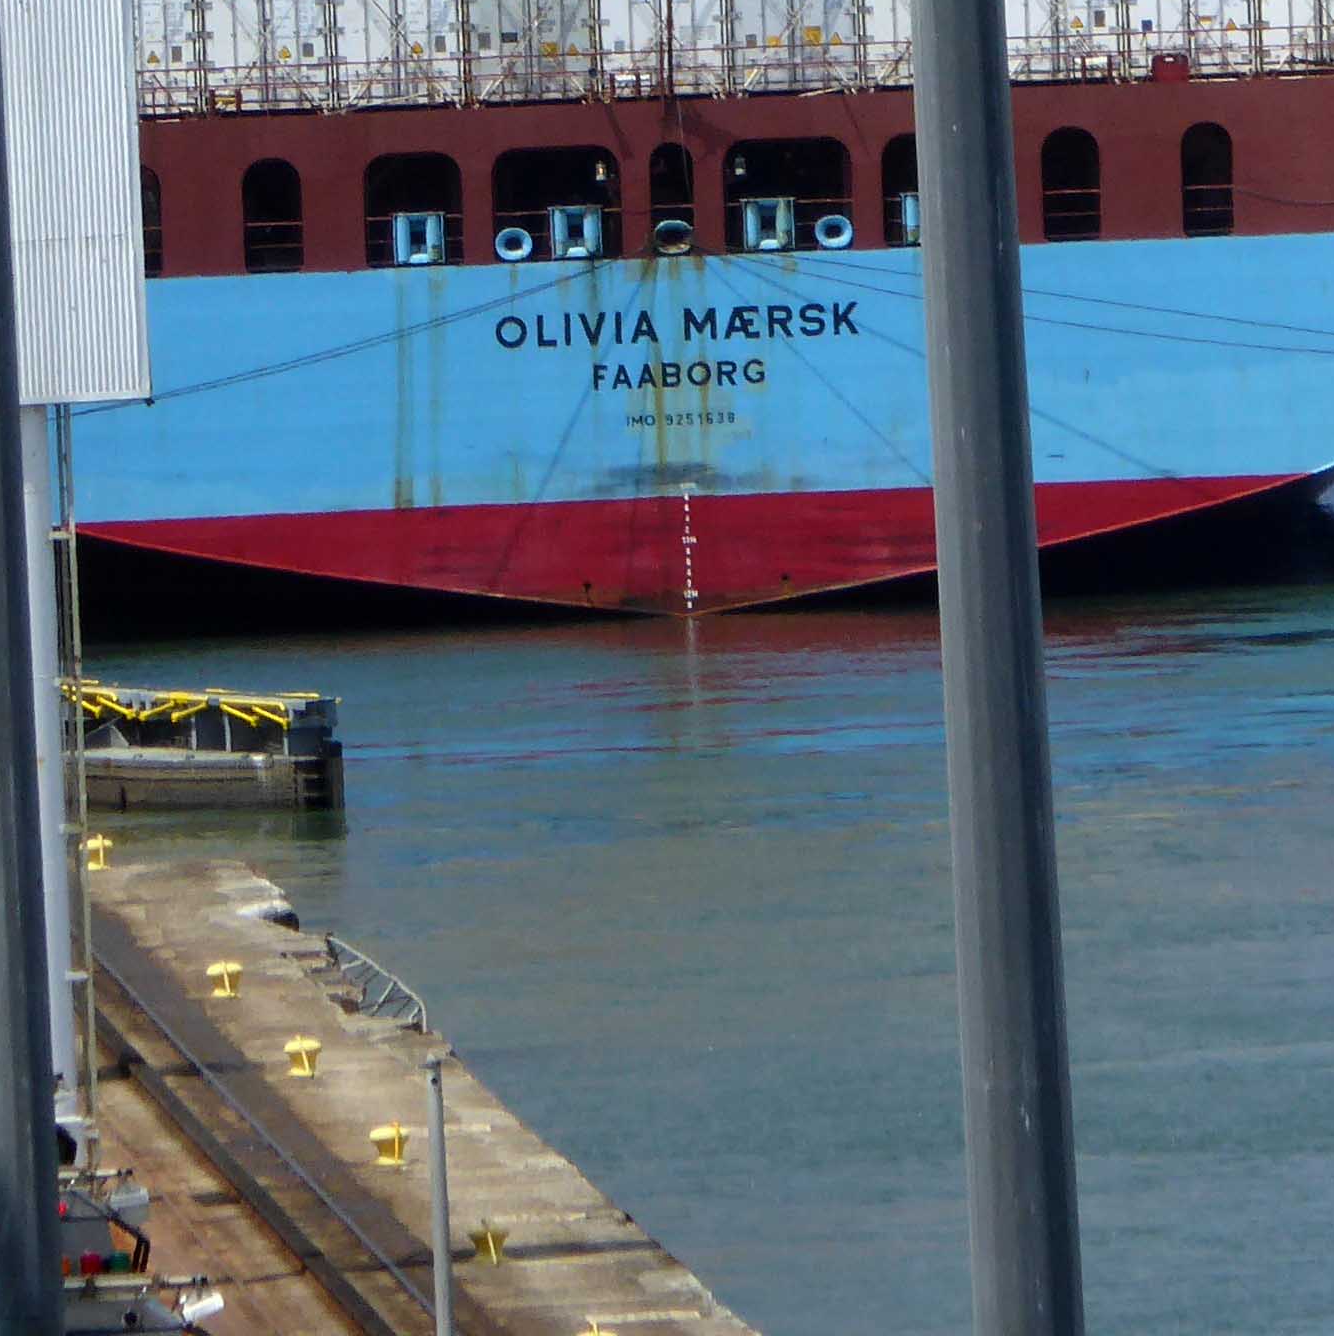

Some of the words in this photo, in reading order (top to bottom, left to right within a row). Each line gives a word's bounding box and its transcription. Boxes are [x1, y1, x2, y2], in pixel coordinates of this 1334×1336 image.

[495, 309, 659, 348] OLIVIA
[683, 301, 859, 341] MÆRSK
[592, 358, 766, 391] FAABORG
[626, 414, 656, 427] IMO
